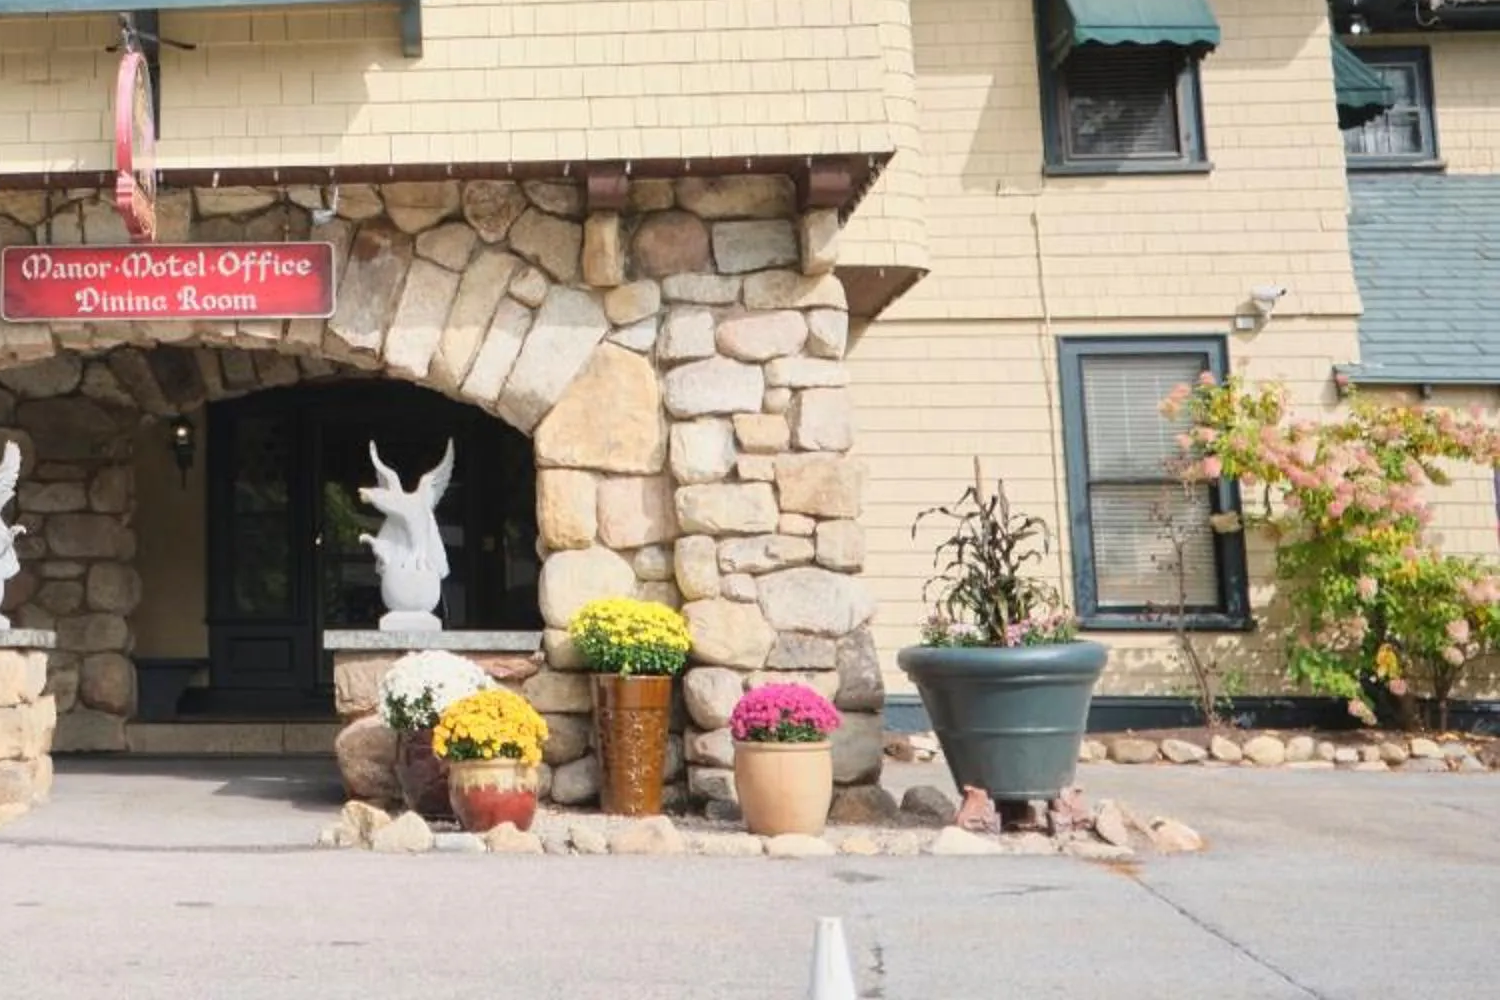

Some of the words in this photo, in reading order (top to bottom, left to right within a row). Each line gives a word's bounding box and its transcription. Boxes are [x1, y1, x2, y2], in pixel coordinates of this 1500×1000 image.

[21, 253, 111, 280] Manor
[122, 252, 205, 279] Motel
[218, 251, 312, 283] Office
[177, 285, 258, 312] Room
